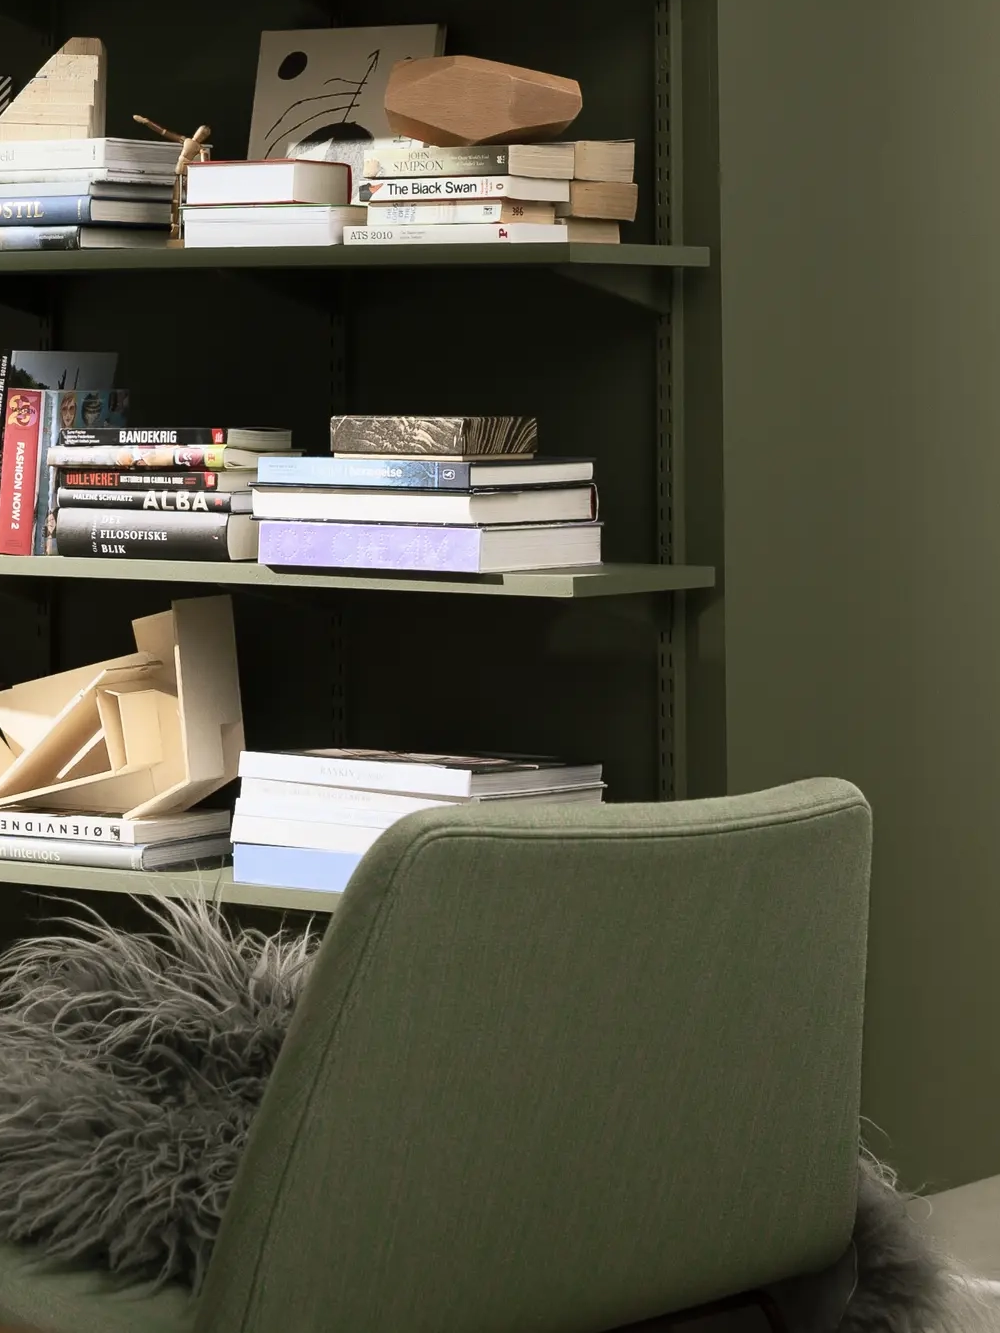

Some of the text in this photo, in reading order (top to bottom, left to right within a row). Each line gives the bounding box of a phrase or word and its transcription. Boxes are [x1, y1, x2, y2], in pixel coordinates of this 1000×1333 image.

[408, 151, 430, 160] JOHN
[393, 159, 444, 173] SIMPSON
[387, 183, 409, 195] The
[411, 182, 442, 195] Black
[445, 181, 477, 194] Swan
[350, 231, 369, 240] ATS
[370, 231, 393, 240] 2010
[0, 355, 8, 377] PHOTOS
[118, 430, 178, 444] BANDEKRIG
[10, 441, 25, 530] FASHION NOW 2
[97, 494, 134, 502] SCHWARTZ
[143, 490, 209, 512] ALBA
[101, 515, 121, 525] DET
[100, 529, 168, 541] FILOSOFISKE
[101, 544, 127, 554] BLIK
[331, 530, 451, 565] CREAM
[8, 845, 62, 862] Interiors
